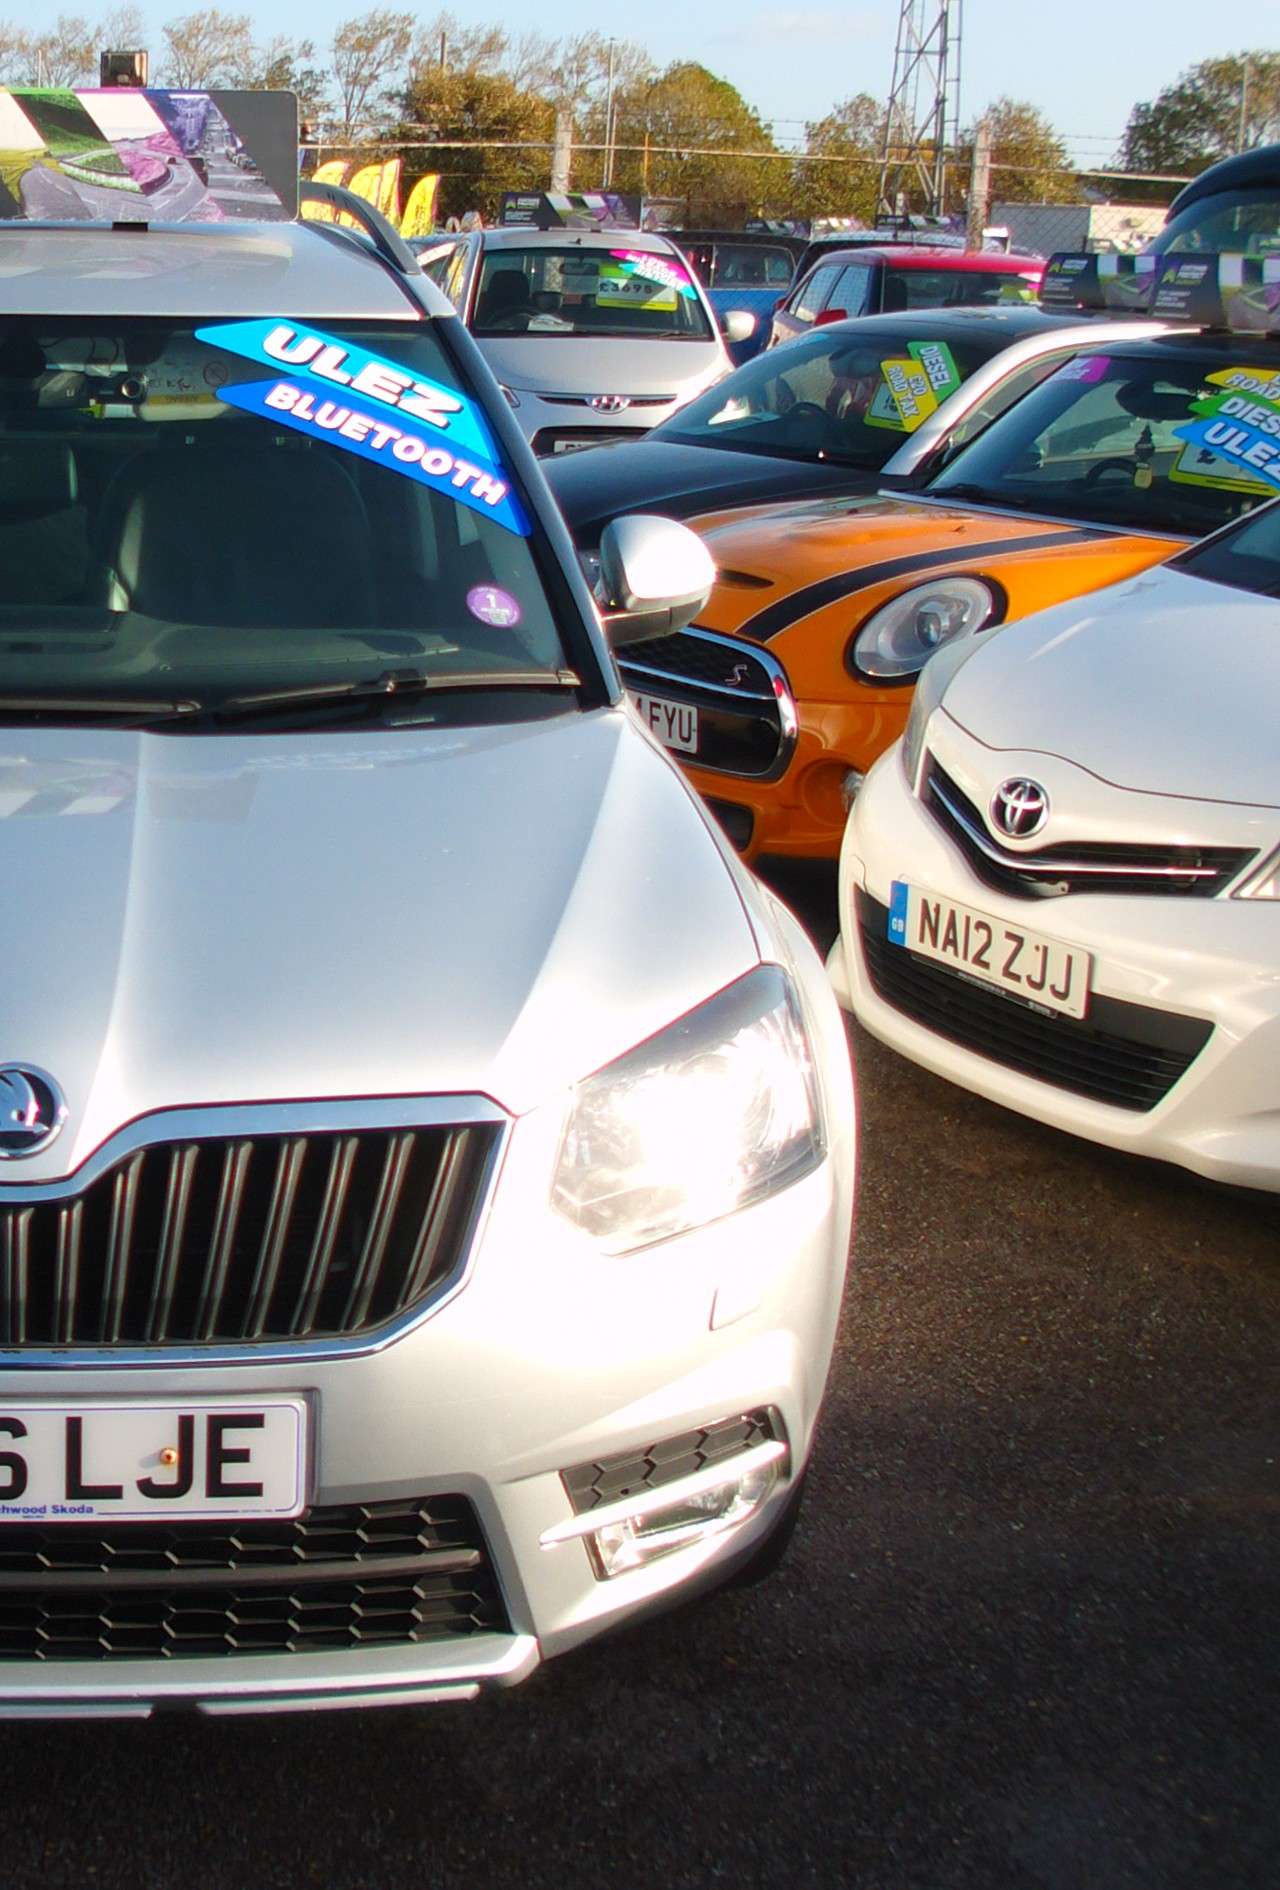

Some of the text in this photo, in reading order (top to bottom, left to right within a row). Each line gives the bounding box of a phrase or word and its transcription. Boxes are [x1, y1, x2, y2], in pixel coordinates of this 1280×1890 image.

[262, 325, 464, 430] ULEZ
[887, 366, 909, 392] ROAD
[899, 393, 921, 417] TAX
[919, 345, 952, 390] DIESEL
[264, 382, 510, 507] BLUETOOTH
[1218, 396, 1280, 439] DIES
[918, 897, 1073, 1001] NA12 ZJJ
[65, 1412, 266, 1501] LJE
[51, 1504, 94, 1514] Skoda
